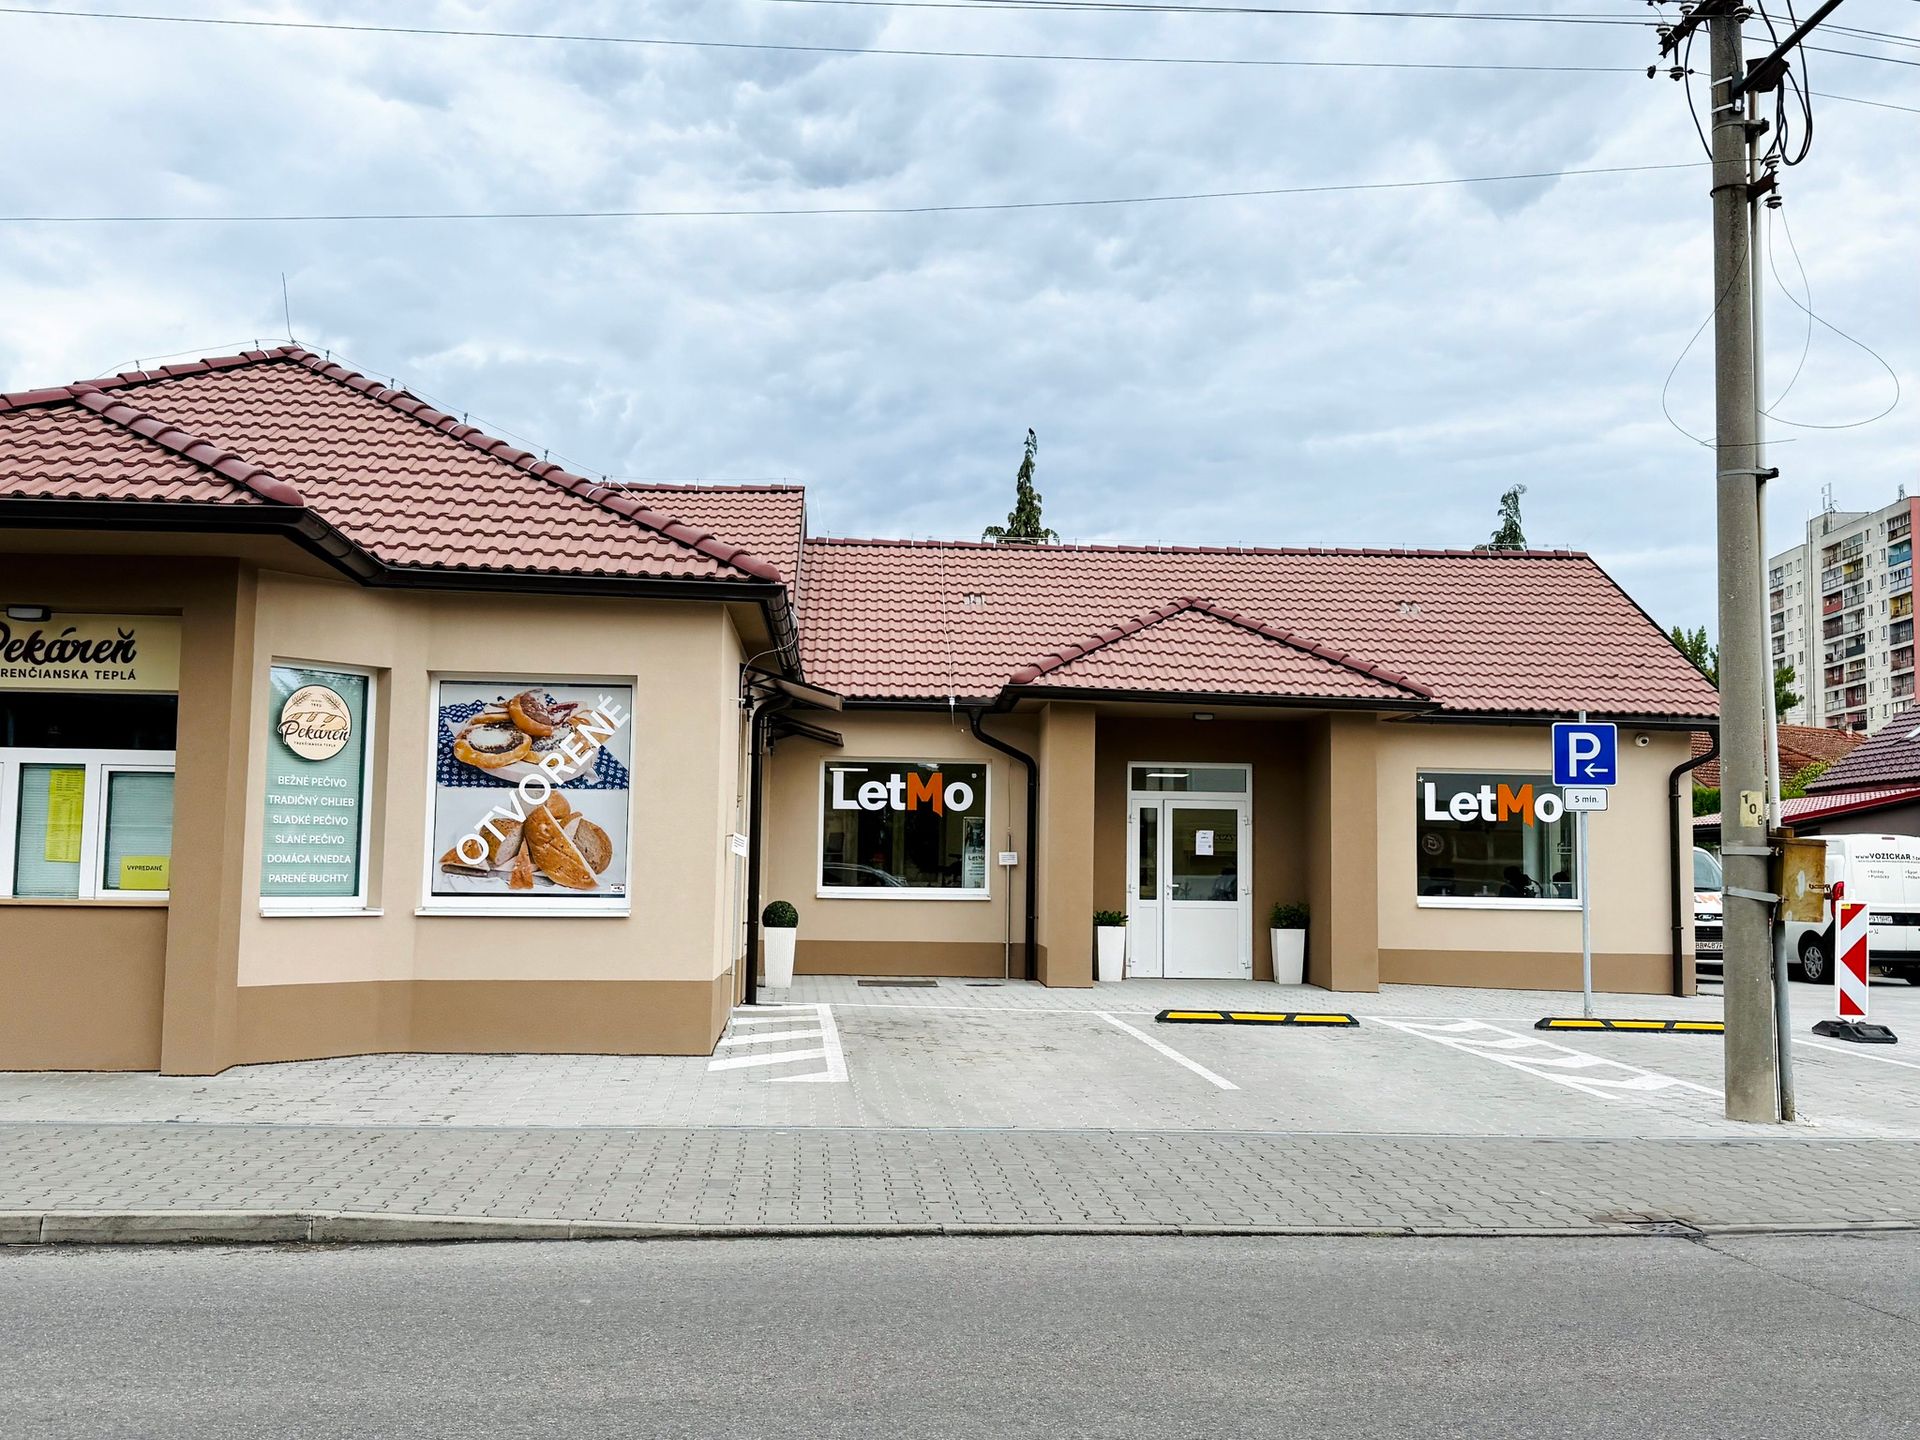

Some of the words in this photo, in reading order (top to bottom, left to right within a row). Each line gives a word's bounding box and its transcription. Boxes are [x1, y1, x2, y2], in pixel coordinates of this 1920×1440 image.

[95, 669, 136, 680] TEPLÁ
[1568, 732, 1601, 777] P
[278, 775, 309, 786] BEŽNÉ
[311, 776, 347, 788] PEČIVO
[456, 693, 630, 865] OTVORENÉ
[268, 794, 319, 806] TRADIČNÝ
[320, 797, 355, 807] CHLIEB
[832, 771, 973, 818] LetMo
[1574, 795, 1580, 803] 5
[1424, 782, 1564, 828] LetMo
[272, 814, 311, 825] SLADKÉ
[313, 814, 349, 826] PEČIVO
[275, 833, 307, 844] SLANÉ
[309, 833, 345, 845] PEČIVO
[267, 852, 311, 863] DOMÁCA
[268, 872, 308, 883] PARENÉ
[309, 873, 349, 883] BUCHTY
